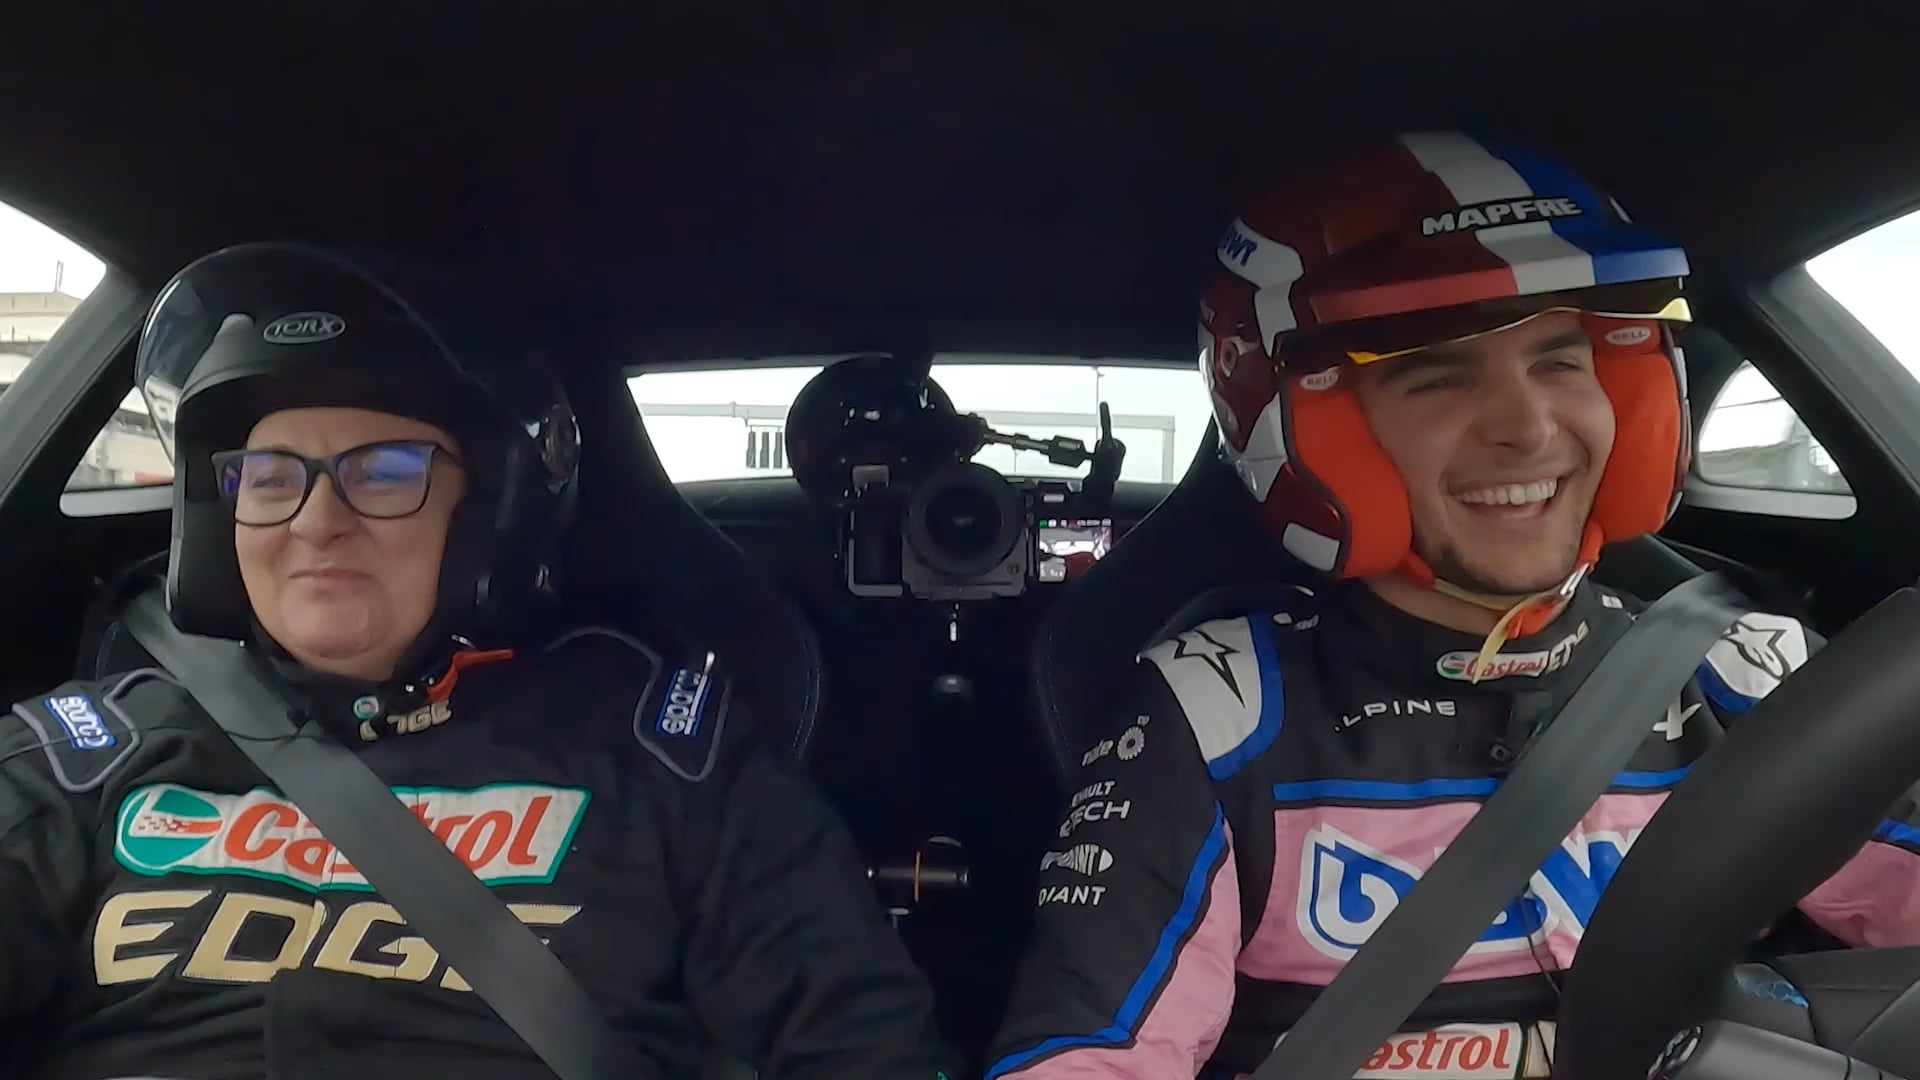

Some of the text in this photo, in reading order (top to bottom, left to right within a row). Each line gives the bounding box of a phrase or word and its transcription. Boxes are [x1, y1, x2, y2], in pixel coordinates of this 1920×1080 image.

[1422, 199, 1582, 235] MAPFRE
[271, 316, 334, 338] TORX
[1334, 700, 1456, 731] LPINE
[1360, 1028, 1510, 1071] astrol
